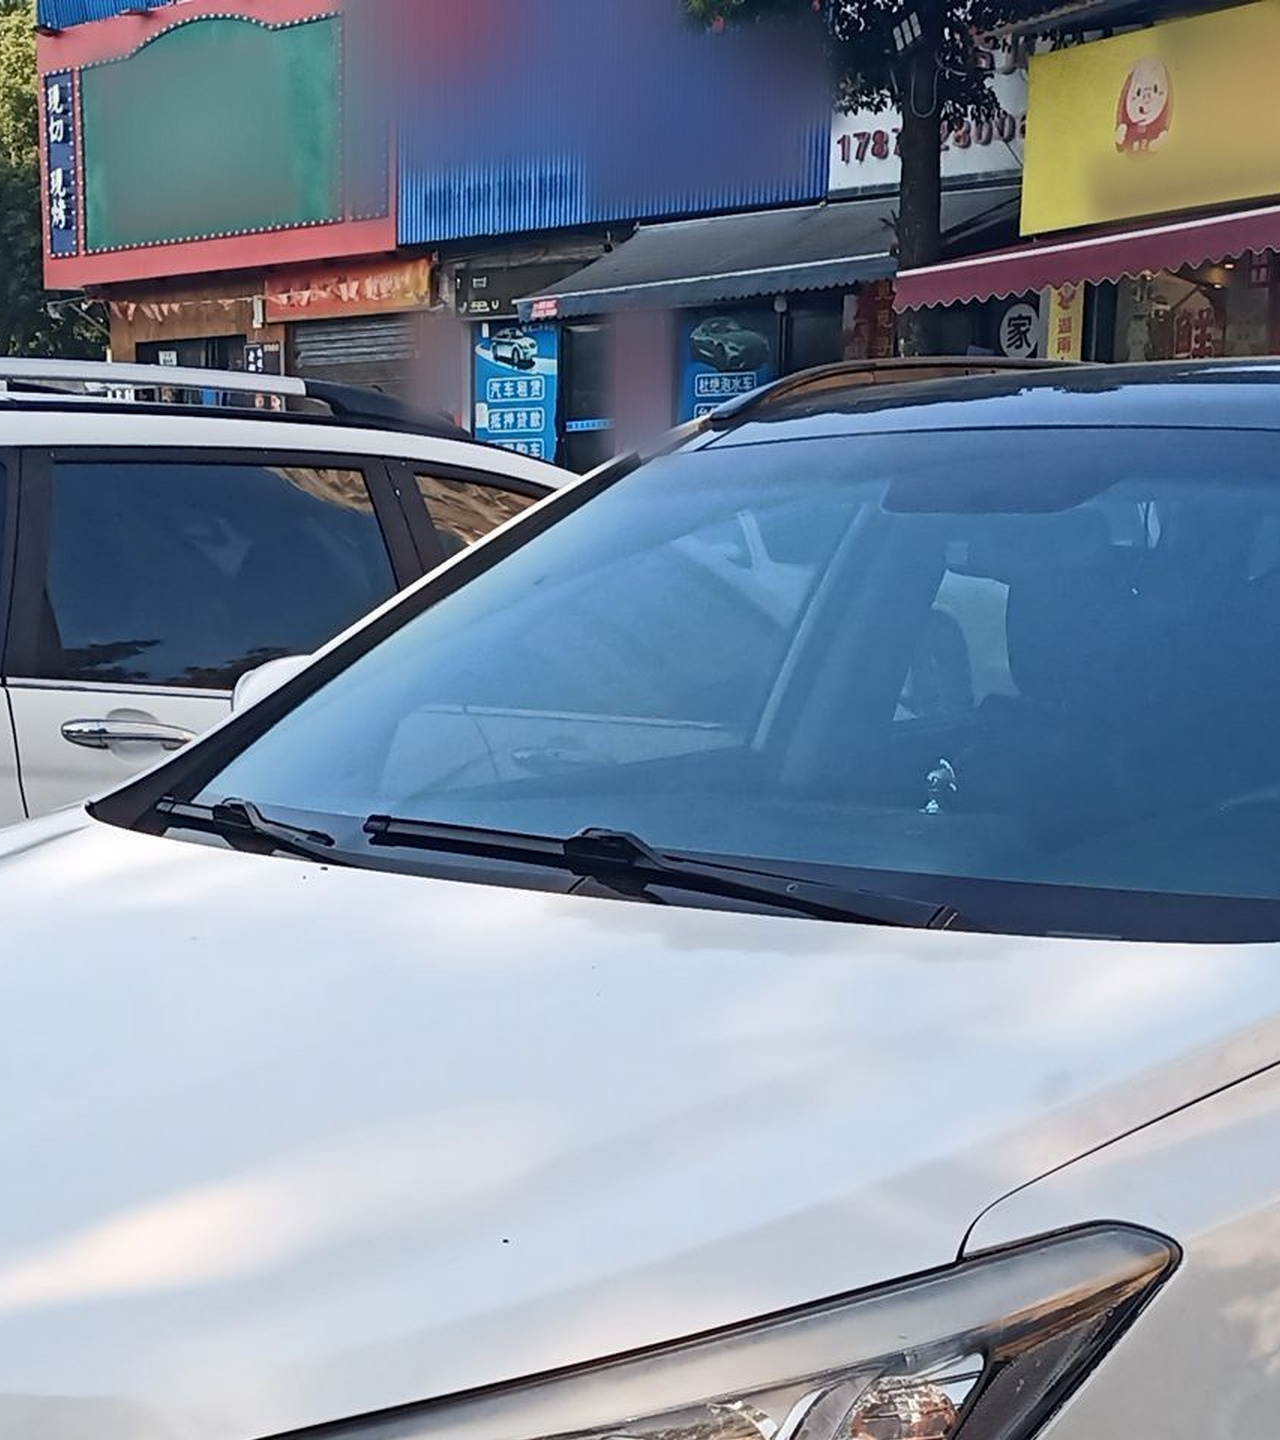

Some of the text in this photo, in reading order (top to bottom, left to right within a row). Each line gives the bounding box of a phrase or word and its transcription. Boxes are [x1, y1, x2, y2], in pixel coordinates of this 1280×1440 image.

[1006, 313, 1033, 350] 家
[489, 380, 541, 399] 汽车租赁
[489, 412, 542, 430] 抵押贷款
